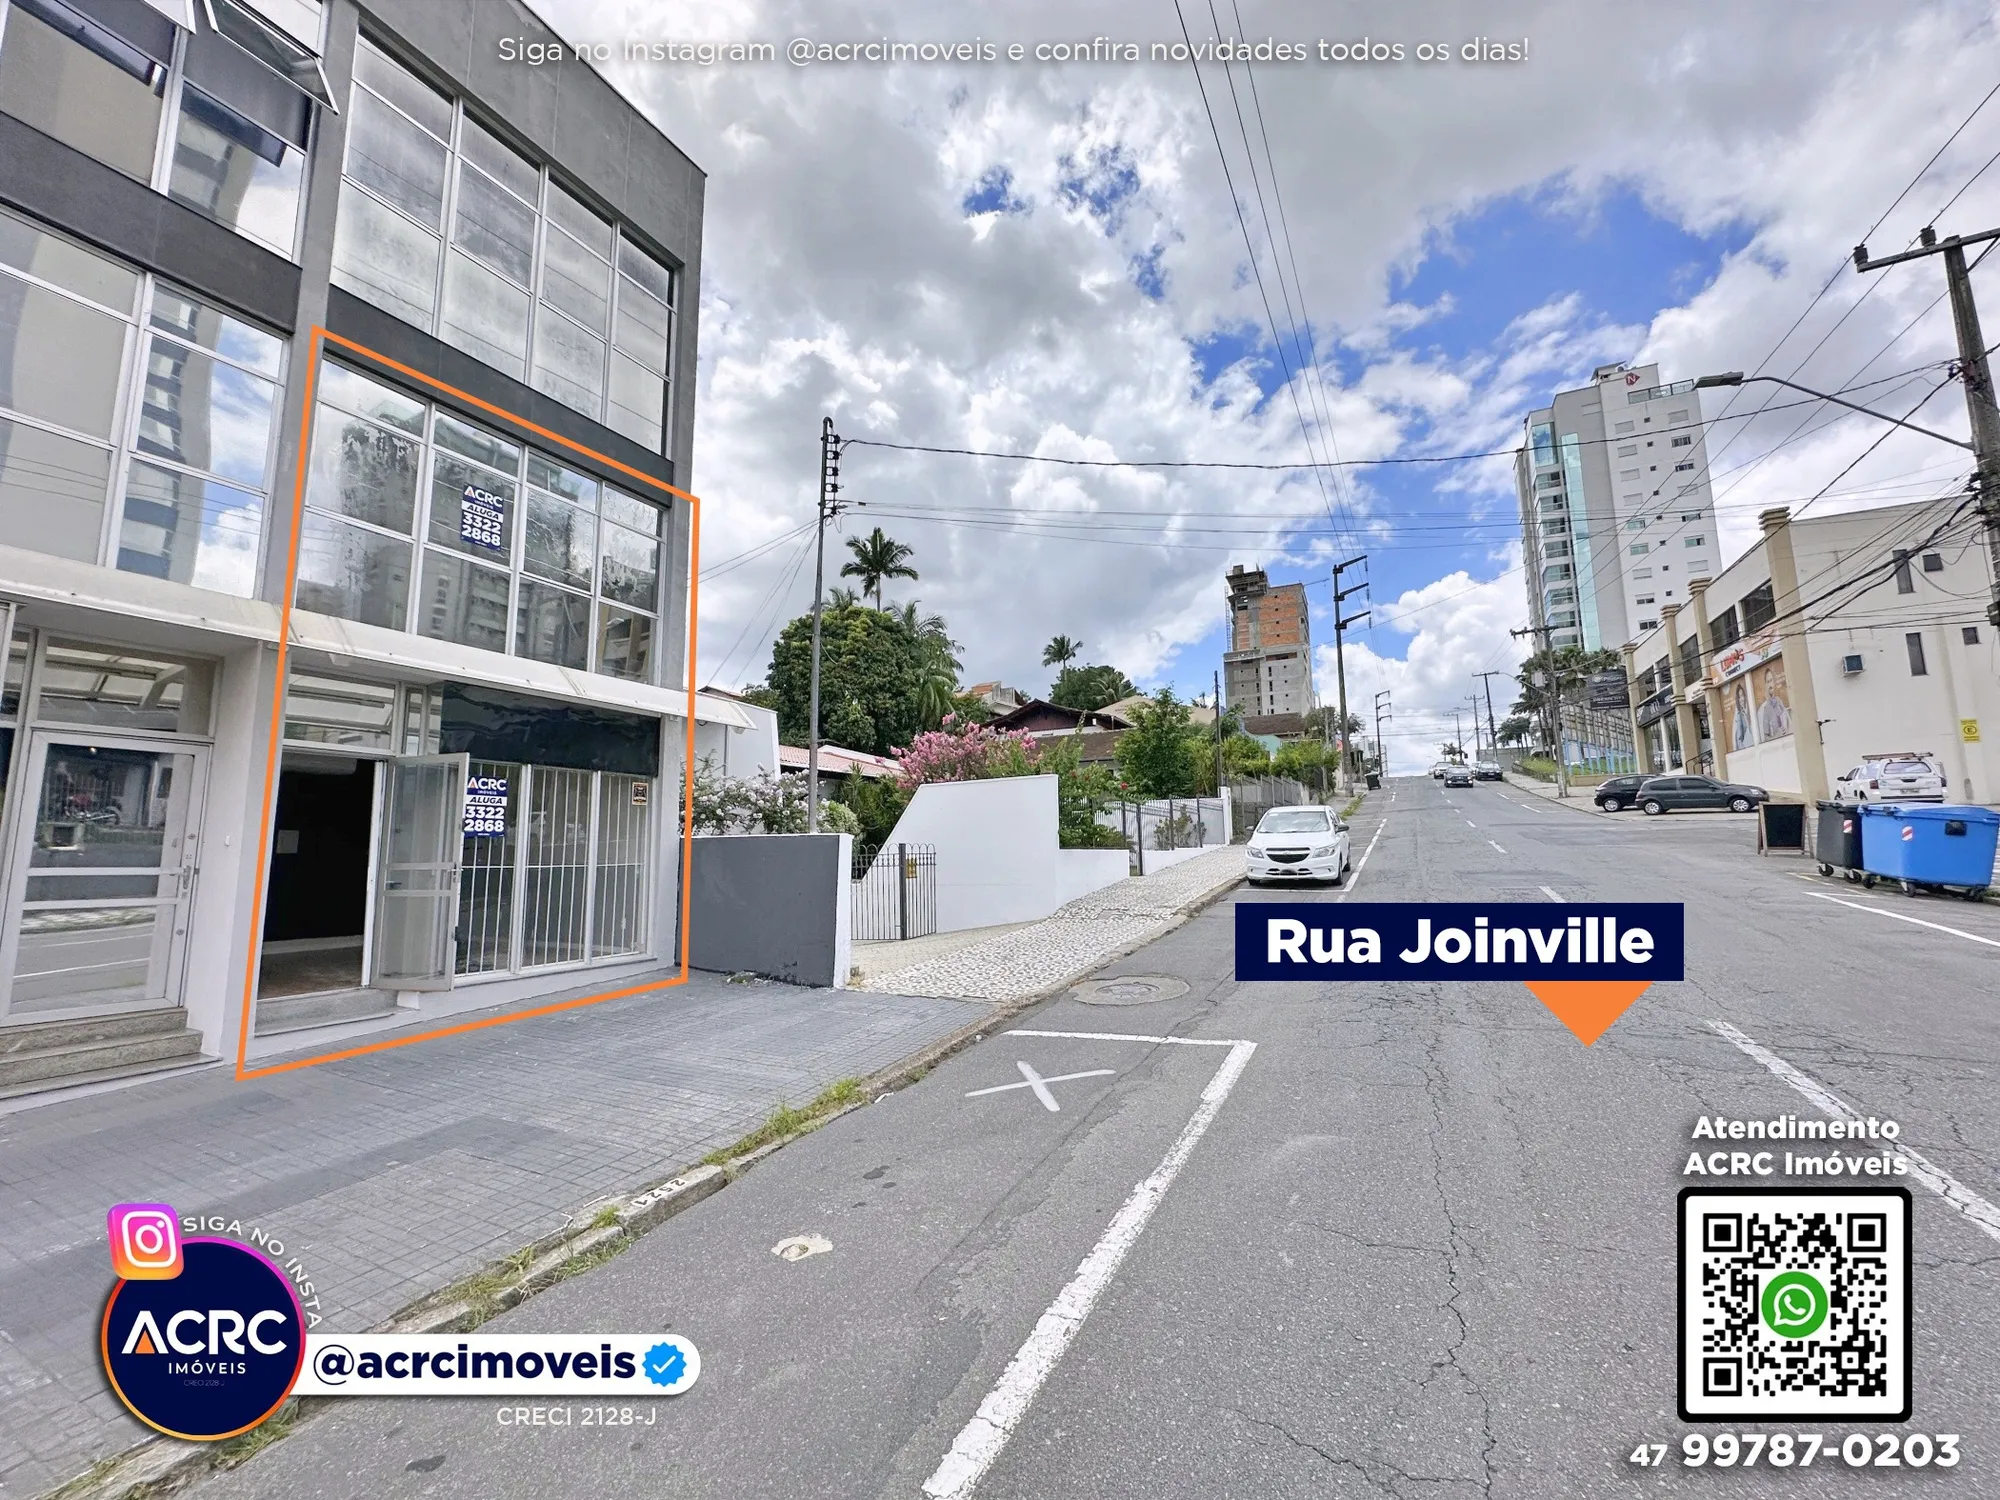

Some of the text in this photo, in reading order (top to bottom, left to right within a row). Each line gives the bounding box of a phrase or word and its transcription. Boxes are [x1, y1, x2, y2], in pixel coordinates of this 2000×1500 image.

[464, 486, 503, 507] ACRC
[467, 504, 499, 520] ALUGA
[463, 512, 501, 535] 3322
[461, 525, 500, 546] 2868
[468, 777, 507, 791] ACRC
[470, 796, 503, 804] ALUGA
[465, 806, 505, 819] 3322
[464, 819, 504, 832] 2868
